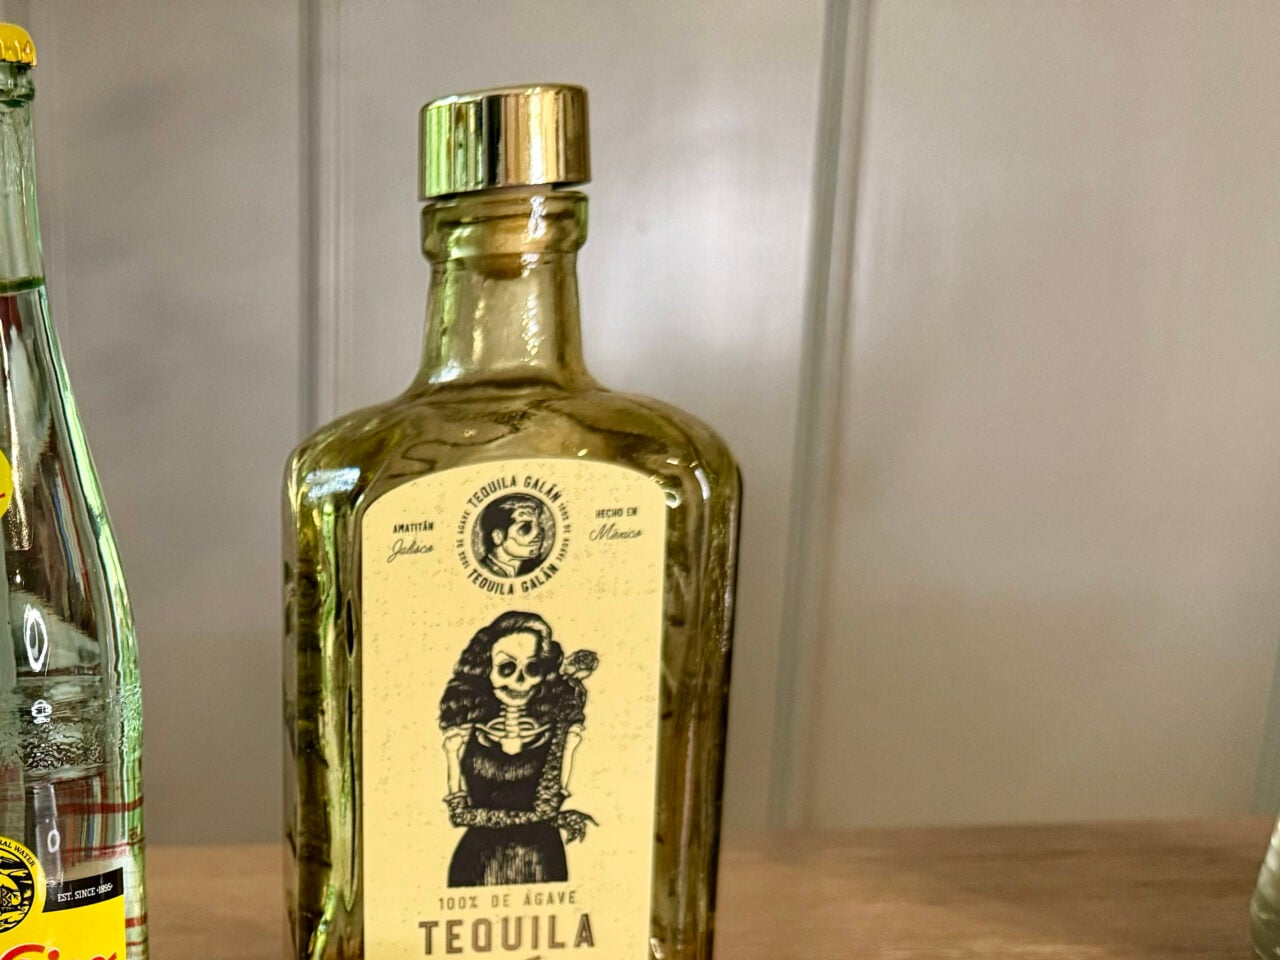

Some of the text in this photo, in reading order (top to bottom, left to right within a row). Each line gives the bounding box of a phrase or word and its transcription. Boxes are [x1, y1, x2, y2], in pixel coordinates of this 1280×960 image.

[467, 475, 562, 507] TEQUILA GALÁN
[595, 508, 623, 519] HECHO
[393, 519, 434, 533] AMATITÁN
[387, 538, 434, 563] Jalisco
[467, 563, 559, 595] TEQUILA GALÁN
[14, 844, 37, 867] WATER
[57, 892, 74, 902] EST.
[74, 886, 96, 899] SINCE
[439, 896, 478, 911] 100%
[491, 893, 511, 908] DE
[418, 912, 595, 956] TEQUILA
